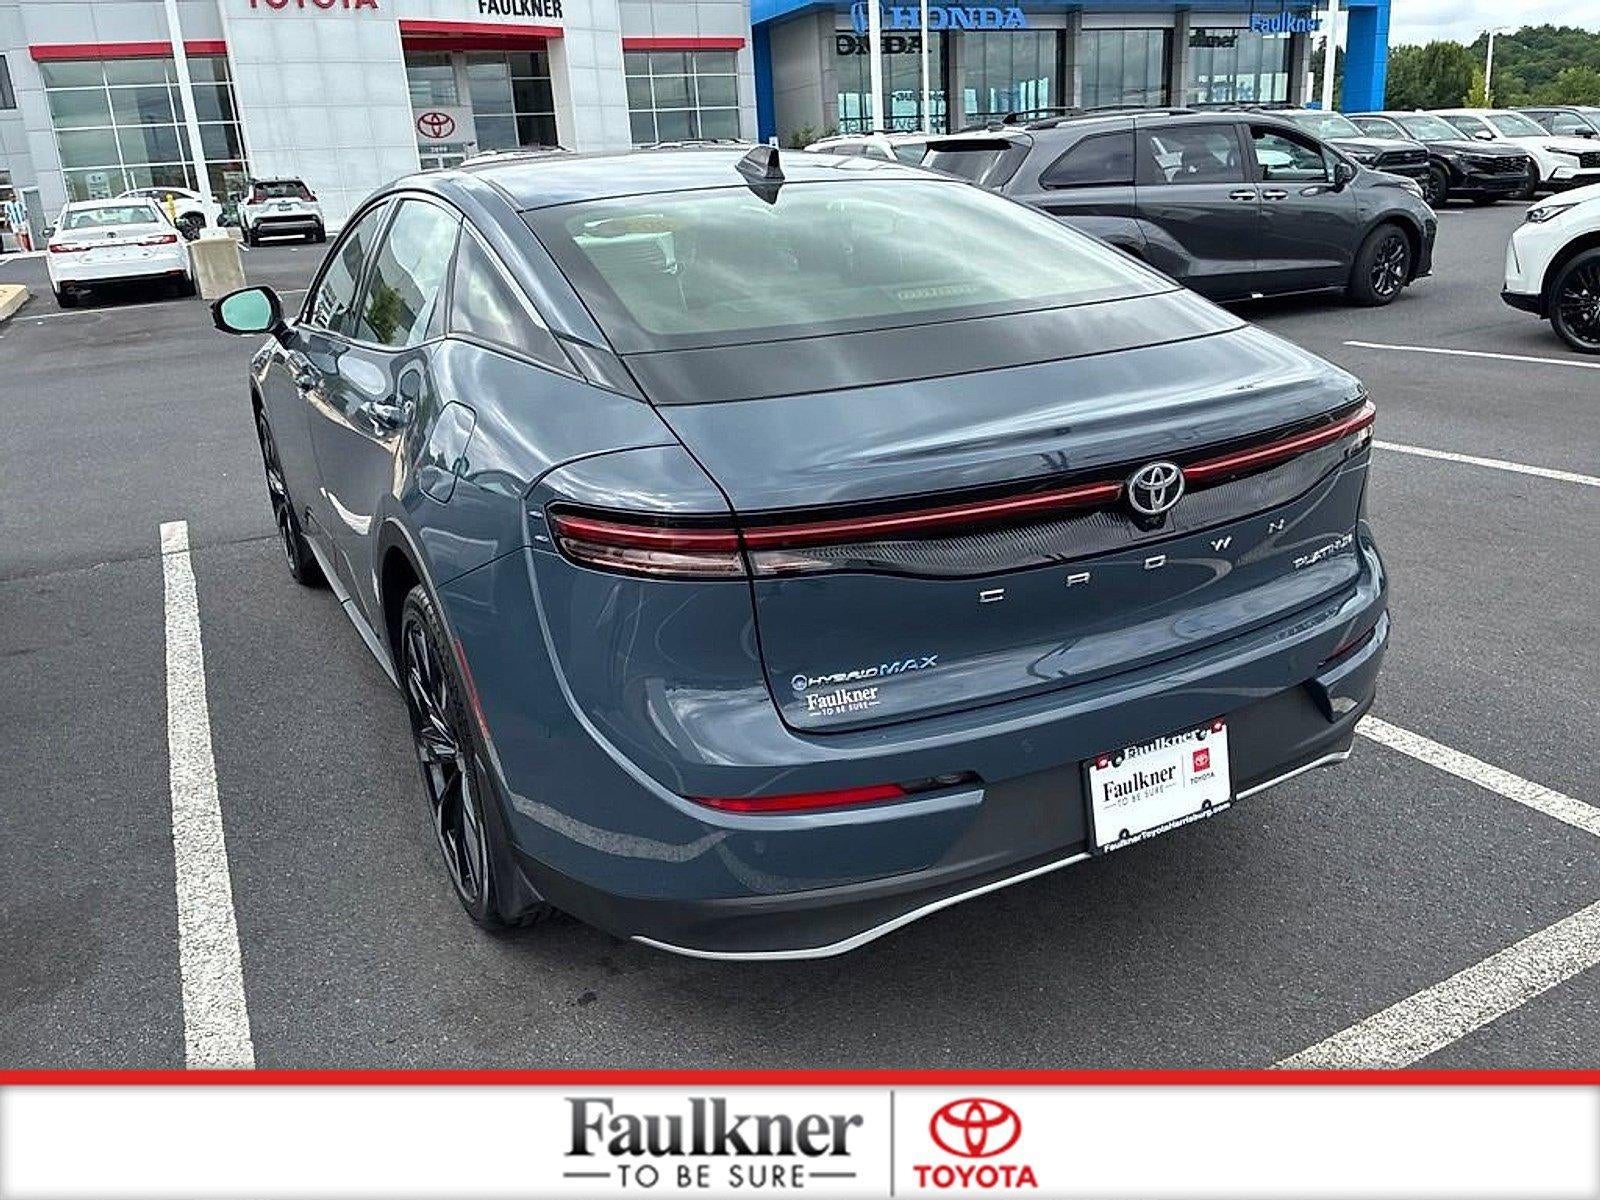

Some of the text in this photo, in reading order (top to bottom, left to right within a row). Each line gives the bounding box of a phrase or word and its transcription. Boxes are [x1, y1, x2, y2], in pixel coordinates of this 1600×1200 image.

[478, 0, 563, 18] FAULKNER
[889, 7, 1027, 29] HONDA
[805, 687, 879, 711] Faulkner
[1103, 765, 1176, 802] Faulkner
[1190, 772, 1215, 785] TOYOTA
[1118, 796, 1129, 807] TO
[1145, 784, 1164, 798] SURE
